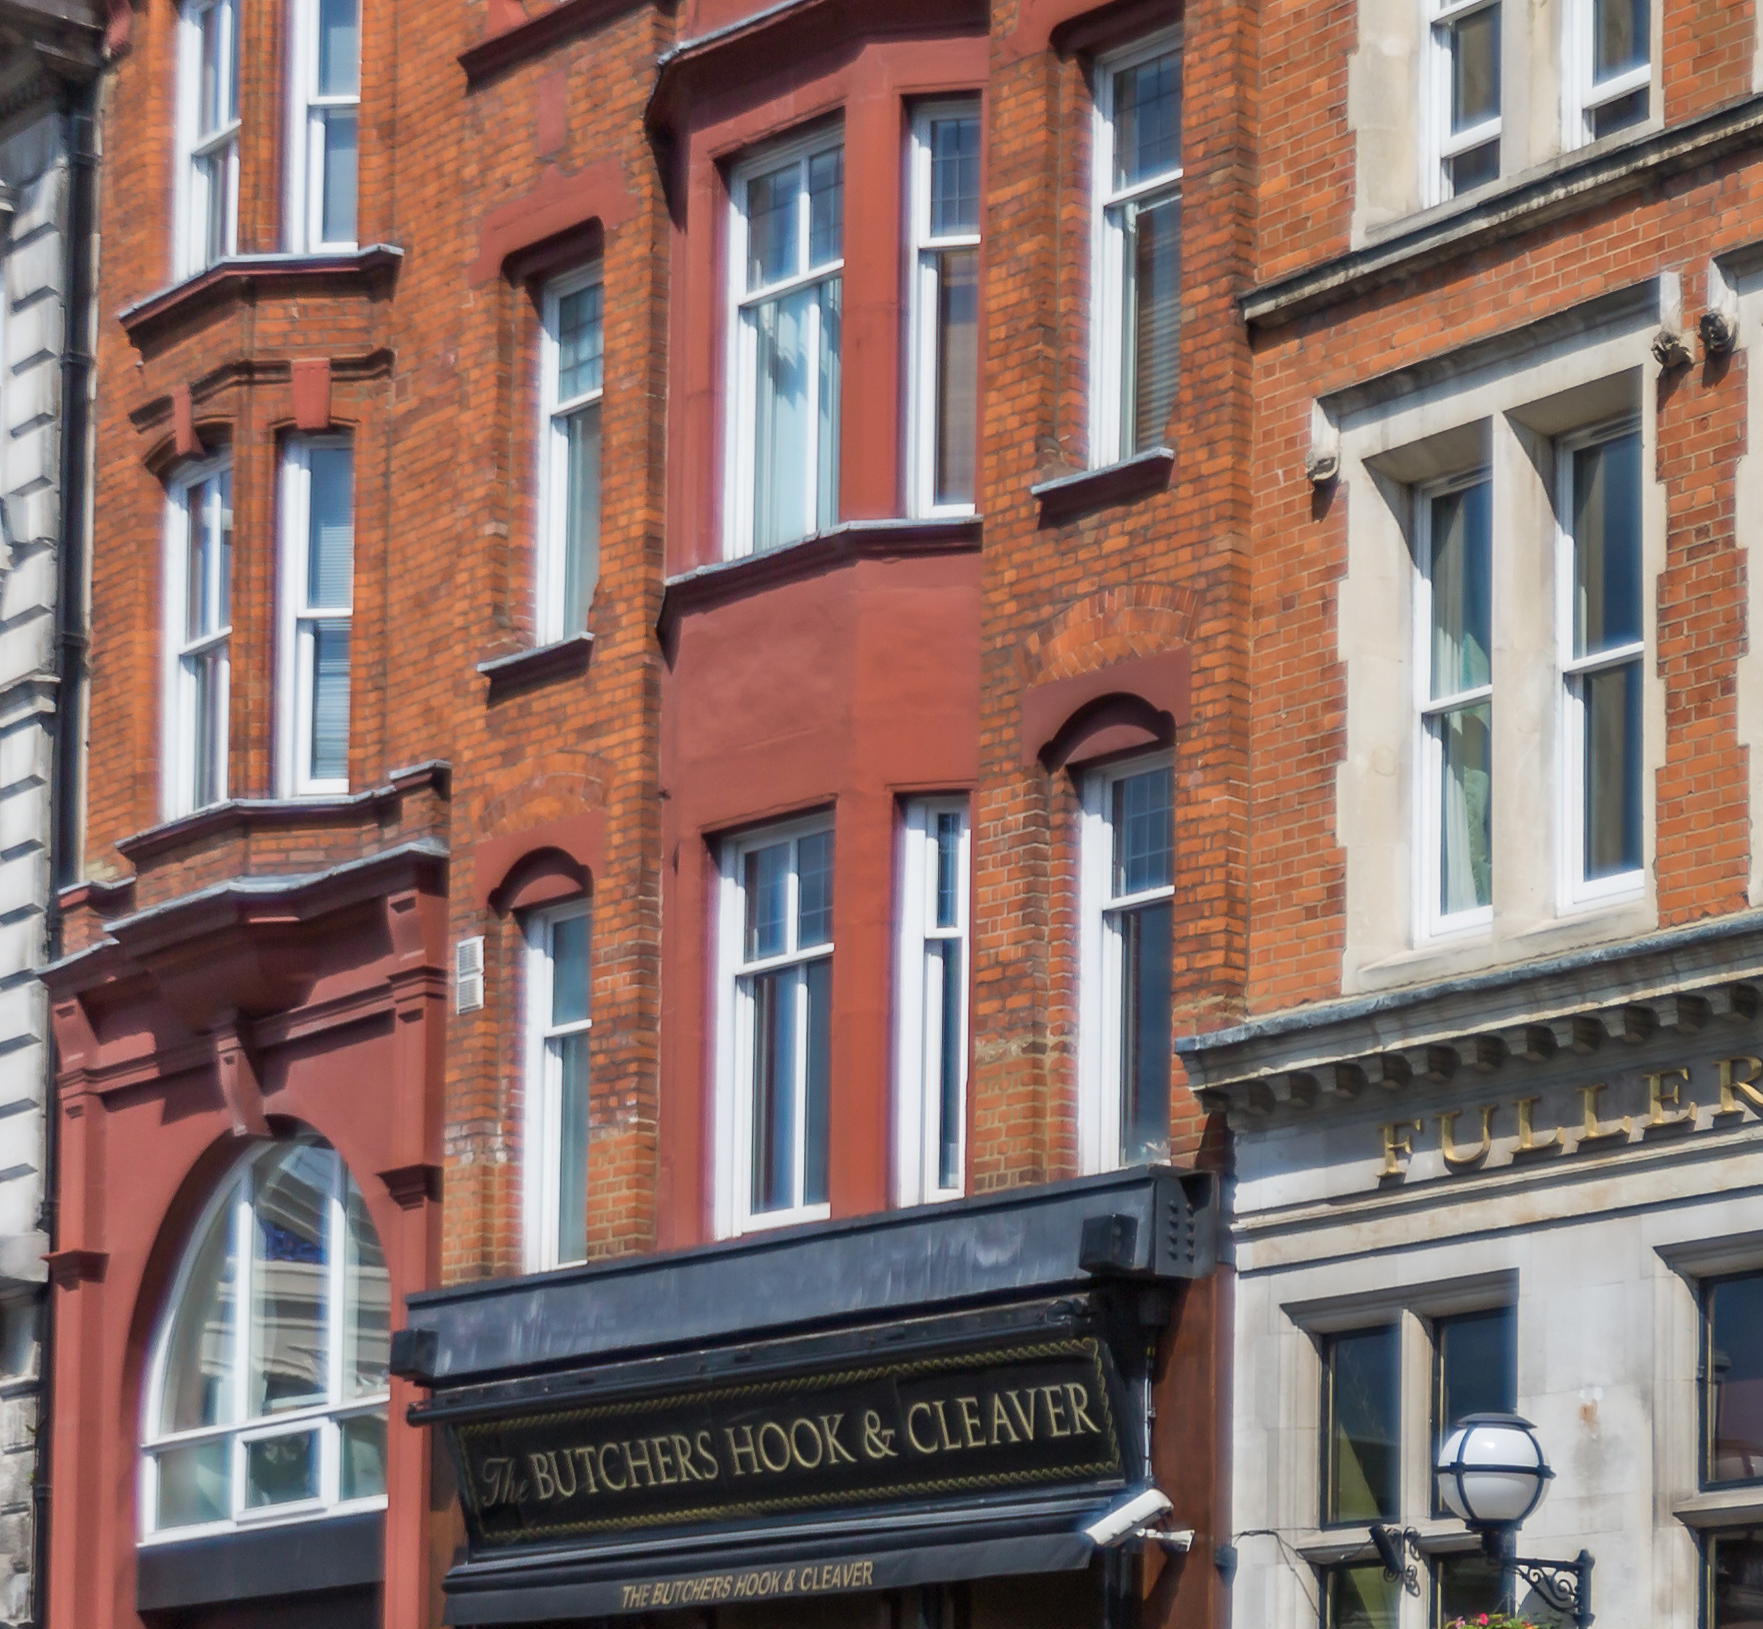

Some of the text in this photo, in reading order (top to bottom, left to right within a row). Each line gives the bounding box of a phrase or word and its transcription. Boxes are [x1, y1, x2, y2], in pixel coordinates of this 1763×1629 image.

[481, 1382, 1102, 1507] The BUTCHERS HOOK & CLEAVER
[621, 1560, 875, 1609] THE BUTCHERS HOOK & CLEAVER
